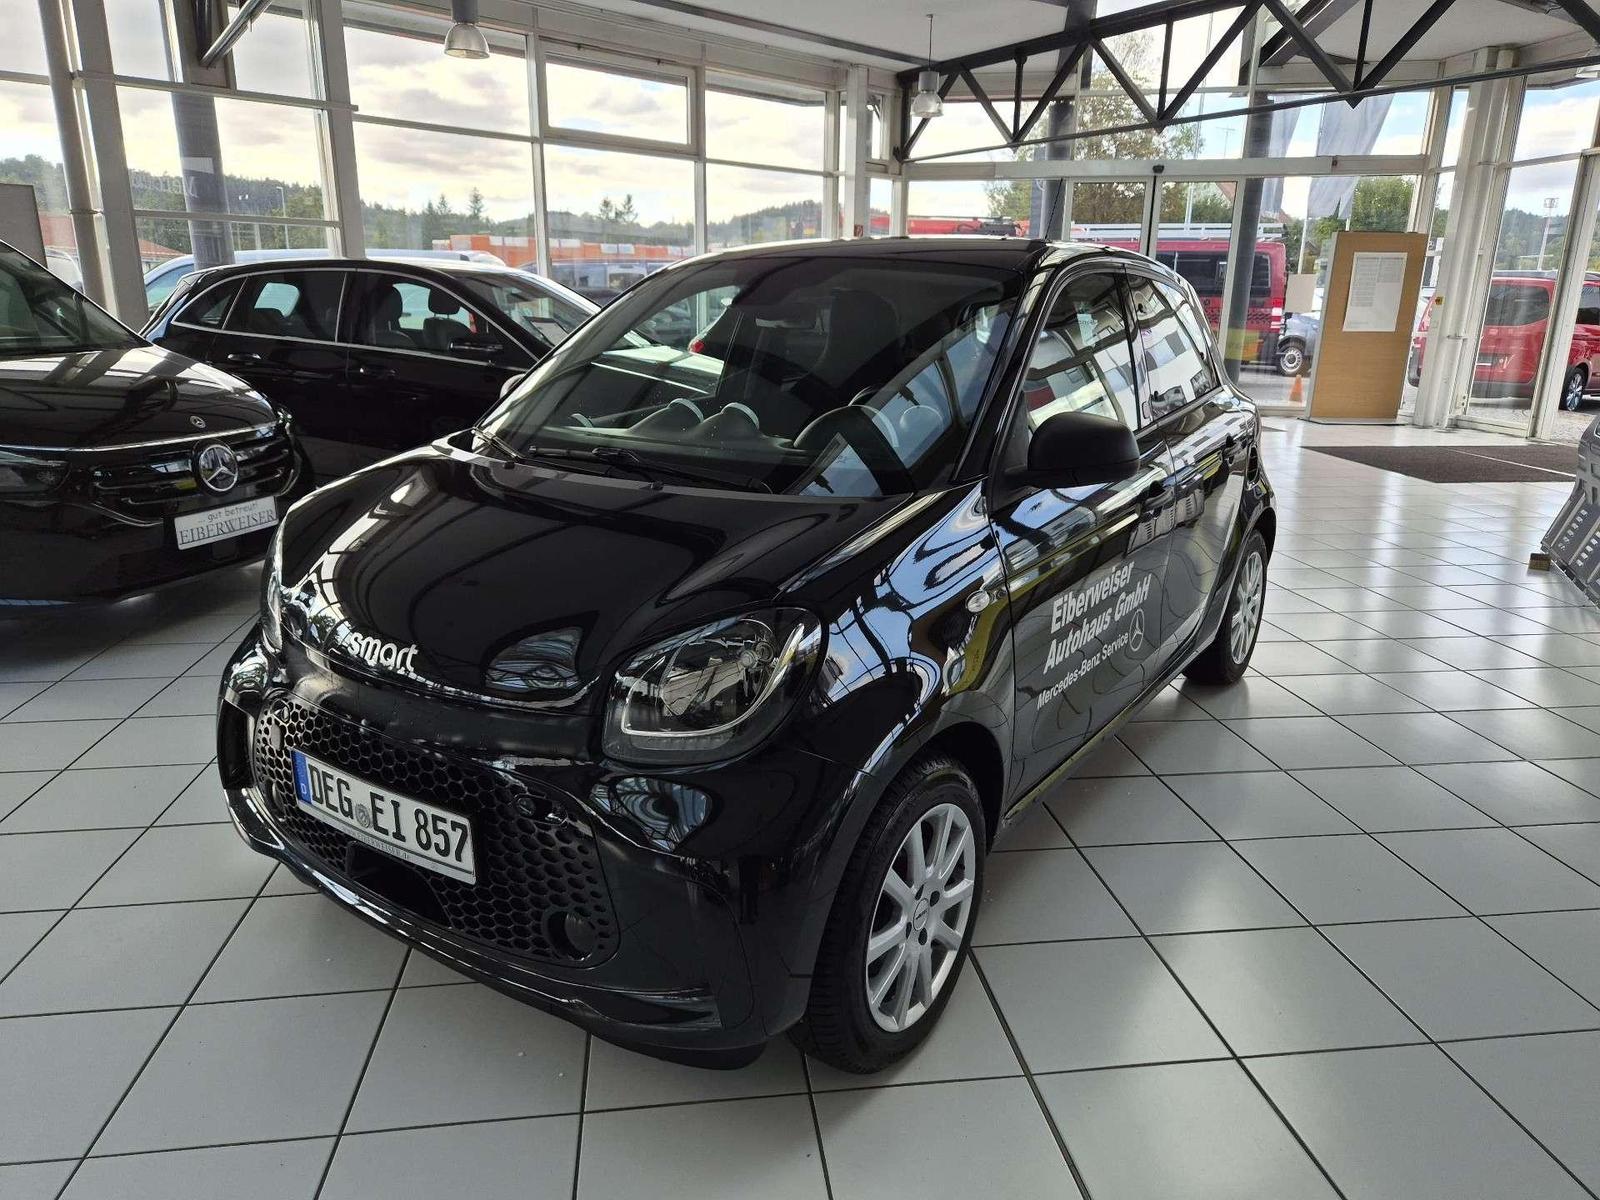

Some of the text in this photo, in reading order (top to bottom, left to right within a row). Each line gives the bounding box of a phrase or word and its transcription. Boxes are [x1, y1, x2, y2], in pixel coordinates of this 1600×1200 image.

[180, 509, 277, 545] EIBERWEISER
[207, 511, 222, 522] gut
[1043, 573, 1152, 675] Autohaus GmbH
[1050, 561, 1135, 634] Eiberweiser
[347, 632, 419, 672] smart
[1037, 632, 1129, 710] Mercedes-Benz Service
[301, 783, 307, 795] D
[308, 764, 468, 863] DEG EI 857
